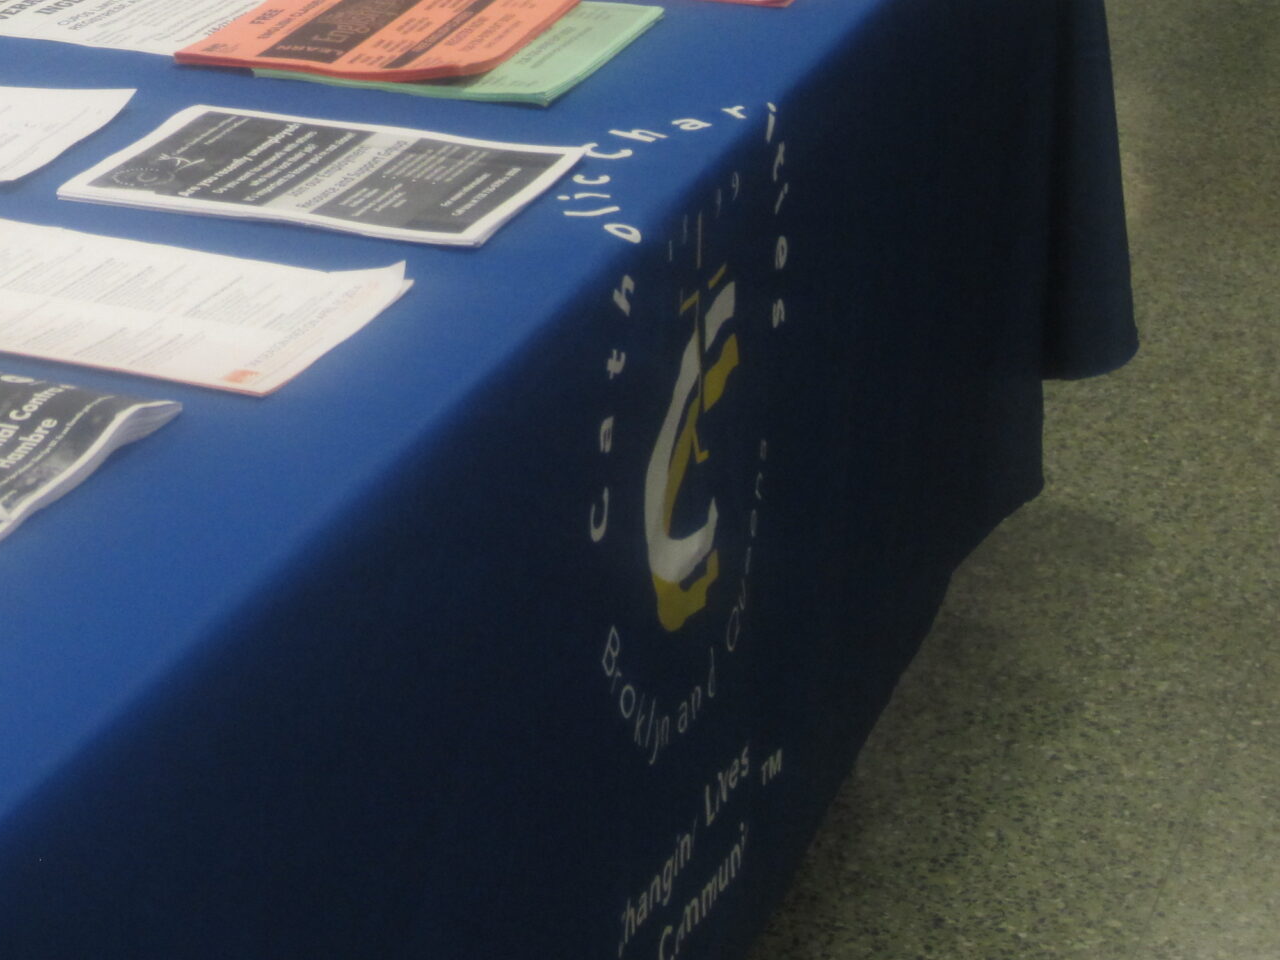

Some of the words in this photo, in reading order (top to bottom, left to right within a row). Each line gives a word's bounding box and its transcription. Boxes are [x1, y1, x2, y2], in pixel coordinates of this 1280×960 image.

[248, 7, 286, 25] FREE
[174, 185, 204, 196] Are
[194, 176, 222, 186] you
[208, 155, 256, 177] recently
